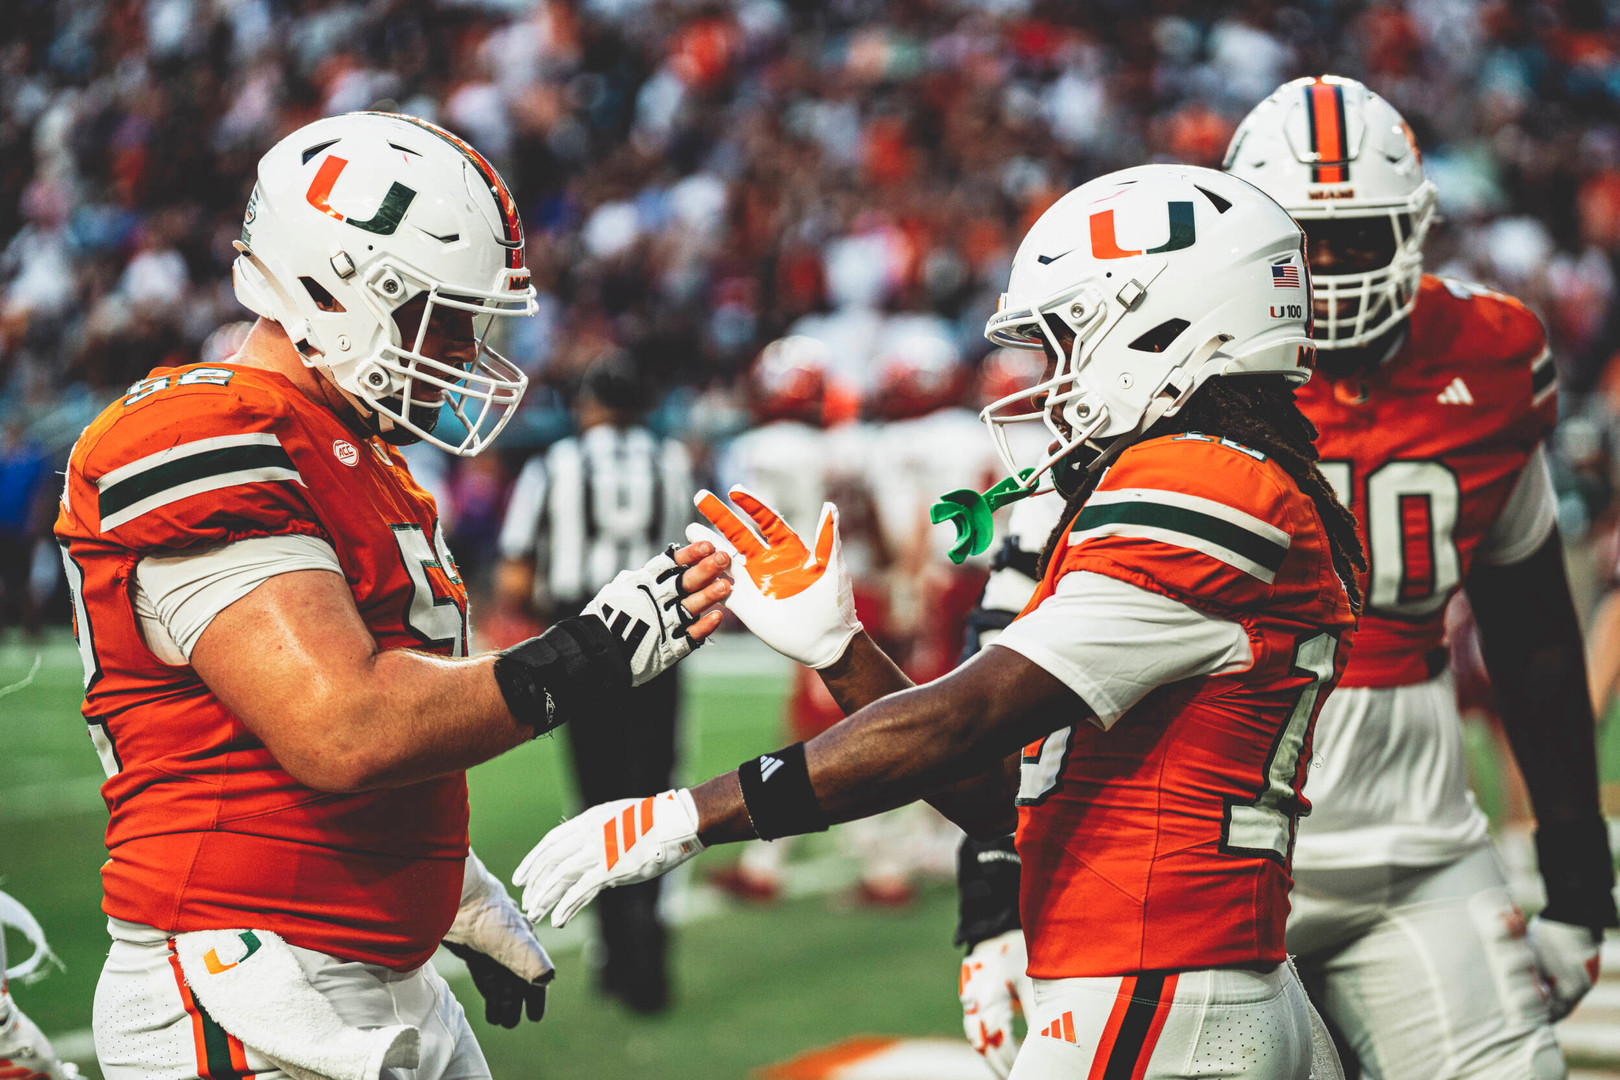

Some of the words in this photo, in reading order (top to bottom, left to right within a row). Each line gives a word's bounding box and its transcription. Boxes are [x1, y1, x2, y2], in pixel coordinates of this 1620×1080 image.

[306, 155, 417, 235] U
[1089, 201, 1196, 260] U
[1287, 305, 1302, 318] 100
[338, 445, 353, 458] ACC
[203, 930, 262, 975] U
